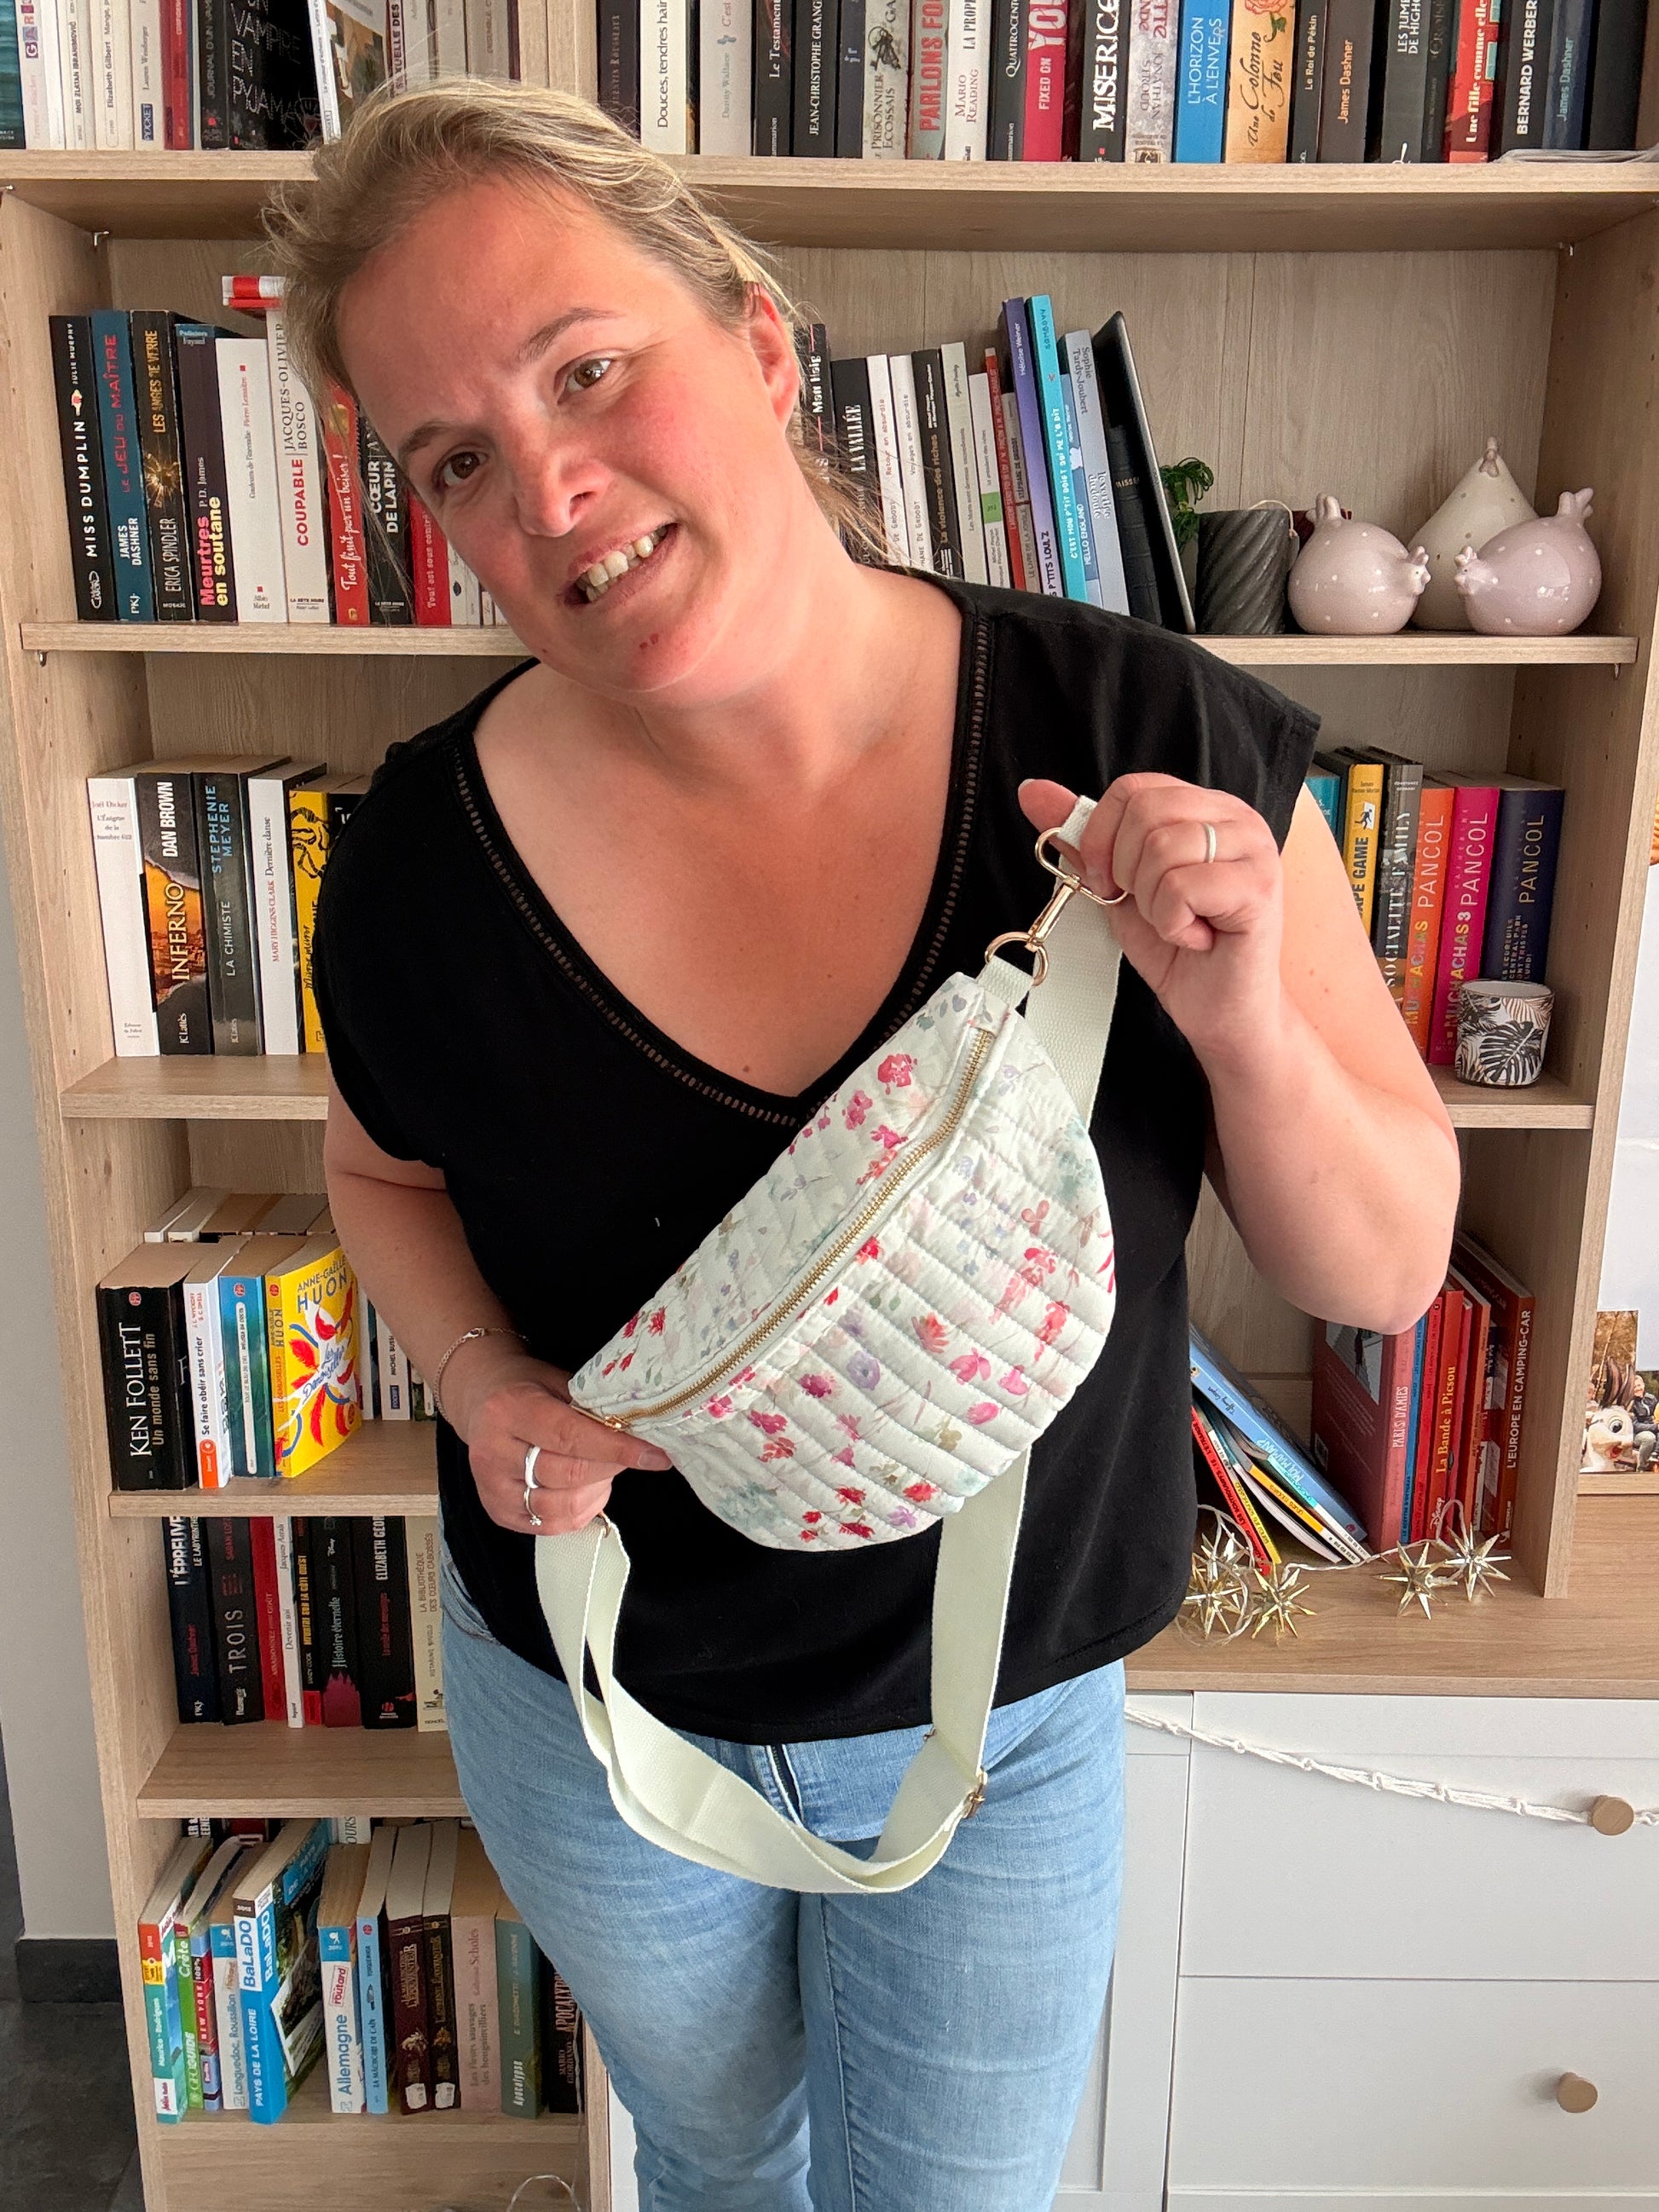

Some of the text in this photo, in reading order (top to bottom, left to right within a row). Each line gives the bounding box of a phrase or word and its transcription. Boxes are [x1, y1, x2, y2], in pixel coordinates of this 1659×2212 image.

[391, 3, 401, 27] DES
[1397, 32, 1408, 53] LES
[962, 37, 976, 49] LA
[1187, 17, 1205, 105] L'HORIZON
[1202, 18, 1226, 105] À L'ENVERS
[1304, 14, 1318, 90] Le Roi Pékin
[1408, 39, 1419, 55] DE
[1474, 28, 1486, 81] comme
[1516, 0, 1538, 136] BERNARD WERBER
[106, 72, 114, 108] Elizabeth
[206, 53, 216, 99] JOURNAL
[656, 26, 669, 129] Douces, tendres
[722, 53, 731, 118] Danny Wallace
[770, 64, 781, 78] Le
[809, 41, 822, 136] JEAN-CHRISTOPHE
[919, 37, 944, 132] PARLONS
[955, 74, 967, 118] MARIO
[966, 68, 980, 123] READING
[1038, 57, 1052, 110] FIXED ON
[1139, 60, 1152, 112] STROUD
[1151, 52, 1165, 119] JONATHAN
[1239, 31, 1262, 147] Une Colonne
[1261, 59, 1284, 123] de Feu
[1337, 39, 1354, 124] James Dashner
[1467, 82, 1482, 113] fille
[1557, 37, 1575, 122] James Dashner
[142, 104, 152, 140] POCKET
[871, 74, 884, 150] PRISONNIER
[883, 88, 895, 149] ECOSSAIS
[1465, 114, 1479, 143] Une
[1012, 322, 1027, 376] Héloïse Weiner
[1079, 346, 1093, 378] Sophie
[275, 322, 295, 452] JACQUES-OLIVIER
[808, 355, 824, 413] Matt Haig
[1071, 348, 1089, 414] Tardy-Joubert
[102, 333, 130, 493] LE JEU MAÎTRE
[151, 413, 165, 433] LES
[293, 401, 308, 450] BOSCO
[841, 403, 865, 453] VALLÉE
[195, 456, 207, 485] James
[849, 455, 867, 472] LA
[930, 433, 941, 465] riches
[72, 419, 98, 558] MISS DUMPLIN
[291, 459, 309, 546] COUPABLE
[367, 460, 383, 514] CŒUR
[382, 461, 399, 534] DE LAPIN
[934, 467, 943, 487] des
[334, 462, 361, 590] Tout finit par un baiser
[935, 488, 948, 529] violence
[118, 524, 131, 559] JAMES
[128, 517, 142, 566] DASHNER
[159, 517, 182, 592] ERICA SPINDLER
[195, 516, 216, 606] Meurtres
[207, 495, 228, 606] en soutane
[425, 546, 434, 569] sous
[939, 530, 950, 544] La
[1067, 537, 1078, 559] C'EST
[427, 586, 436, 609] Tout
[157, 781, 179, 858] DAN BROWN
[205, 785, 223, 874] STEPHENIE
[218, 802, 233, 857] MEYER
[261, 816, 275, 877] Dernière danse
[1390, 811, 1411, 876] FAMILY
[1352, 836, 1368, 879] GAME
[1417, 815, 1445, 908] PANCOL
[1460, 812, 1488, 906] PANCOL
[1517, 814, 1546, 904] PANCOL
[164, 881, 191, 981] INFERNO
[221, 900, 236, 976] LA CHIMISTE
[267, 880, 280, 962] MARY HIGGINS CLARK
[1460, 911, 1471, 921] 3
[296, 1267, 348, 1314] HUON
[273, 1308, 284, 1348] HUON
[118, 1321, 152, 1457] KEN FOLLETT
[142, 1332, 164, 1446] Un monde sans fin
[194, 1336, 211, 1436] Se faire obéir sans crier
[1506, 1310, 1532, 1469] L'EUROPE EN CAMPING-CAR
[1436, 1366, 1457, 1474] La Bande à Picsou
[1429, 1497, 1444, 1530] Disney
[193, 1557, 203, 1567] LE
[279, 1544, 289, 1570] Jacques
[373, 1539, 389, 1581] ELIZABETH
[327, 1596, 348, 1668] Histoire éternelle
[418, 1603, 427, 1613] LA
[428, 1598, 437, 1613] DES
[223, 1608, 247, 1674] TROIS
[284, 1620, 294, 1650] Devenir
[175, 1940, 191, 1978] Crète
[193, 1957, 203, 1981] 100%
[239, 1920, 256, 1988] BaLaDO
[260, 1911, 274, 1982] BaLaDO
[466, 1927, 481, 1966] Scholes
[196, 1984, 205, 2013] YORK
[331, 1967, 347, 2005] routard
[246, 2007, 264, 2106] PAYS DE LA LOIRE
[334, 2014, 353, 2095] Allemagne
